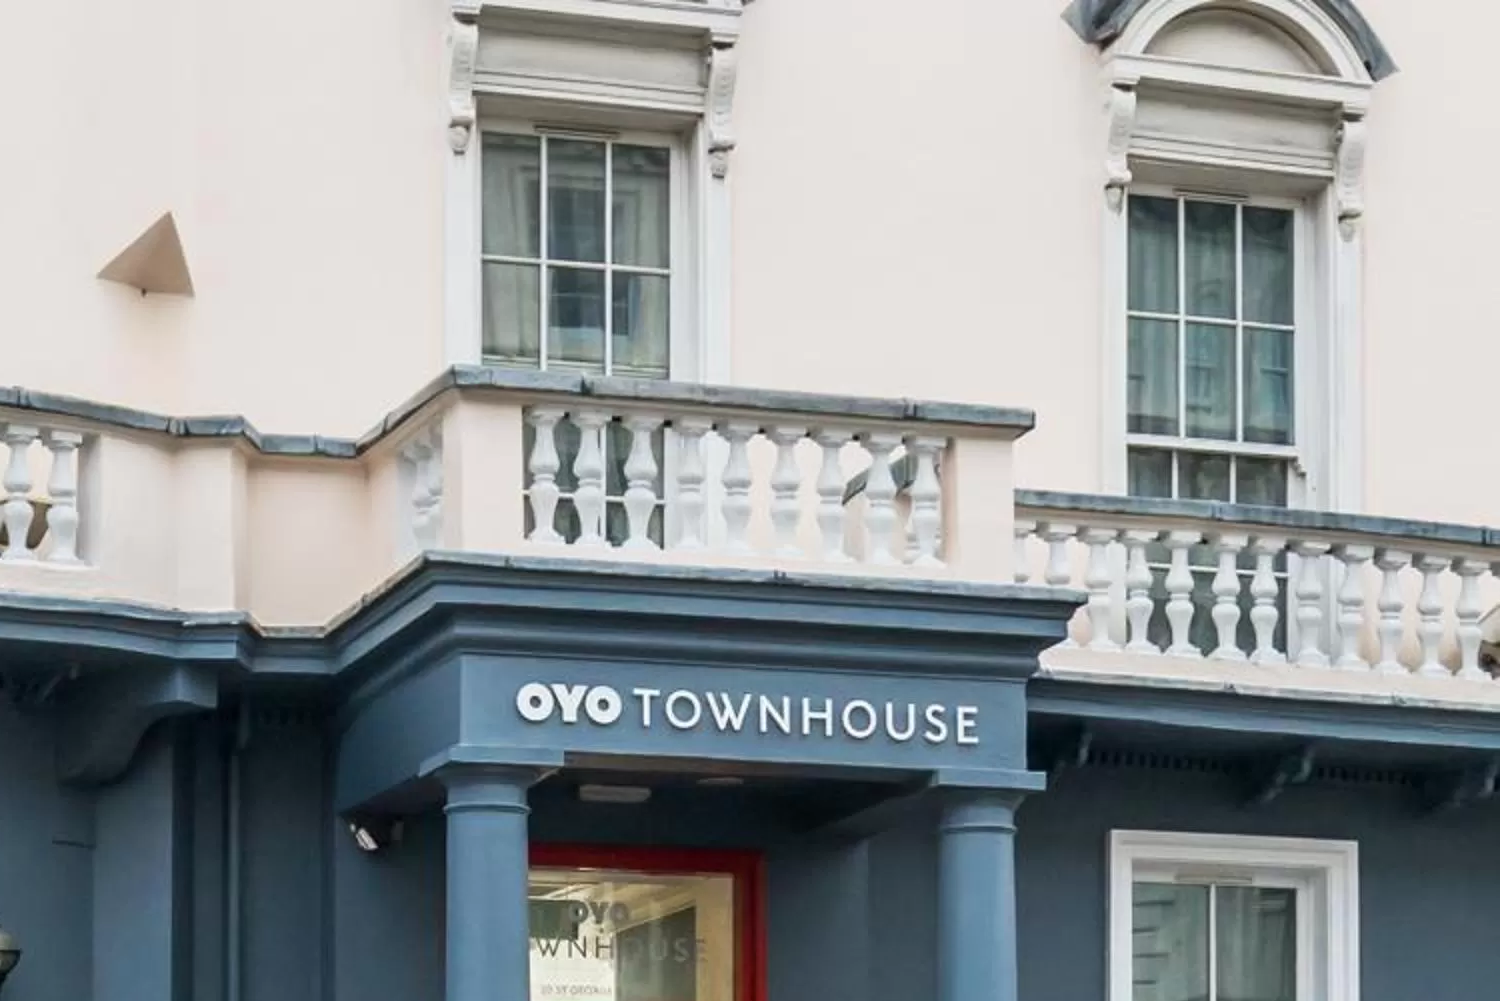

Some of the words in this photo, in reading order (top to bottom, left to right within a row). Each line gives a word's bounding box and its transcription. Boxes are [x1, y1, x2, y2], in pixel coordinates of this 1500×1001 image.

[516, 682, 621, 724] OYO
[632, 687, 980, 744] TOWNHOUSE
[568, 901, 629, 926] OYO
